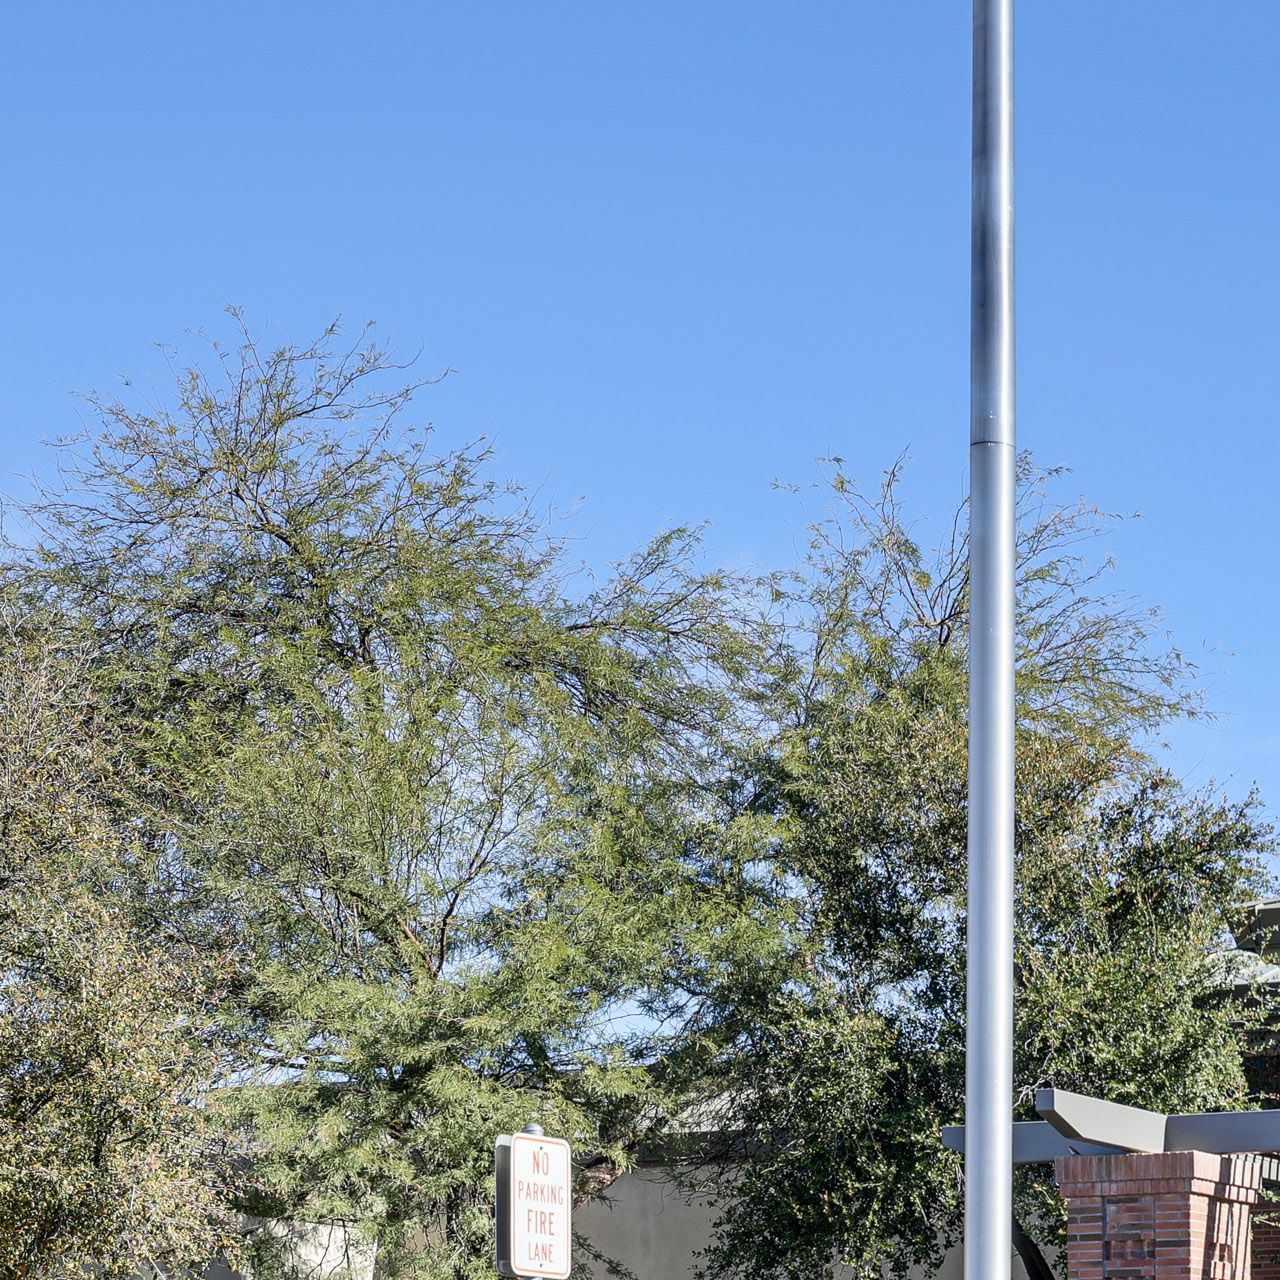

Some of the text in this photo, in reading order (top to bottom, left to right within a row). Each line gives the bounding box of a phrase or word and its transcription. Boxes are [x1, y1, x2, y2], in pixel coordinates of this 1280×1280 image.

[532, 1151, 549, 1176] NO
[518, 1180, 564, 1205] PARKING
[527, 1209, 555, 1236] FIRE
[528, 1242, 554, 1263] LANE
